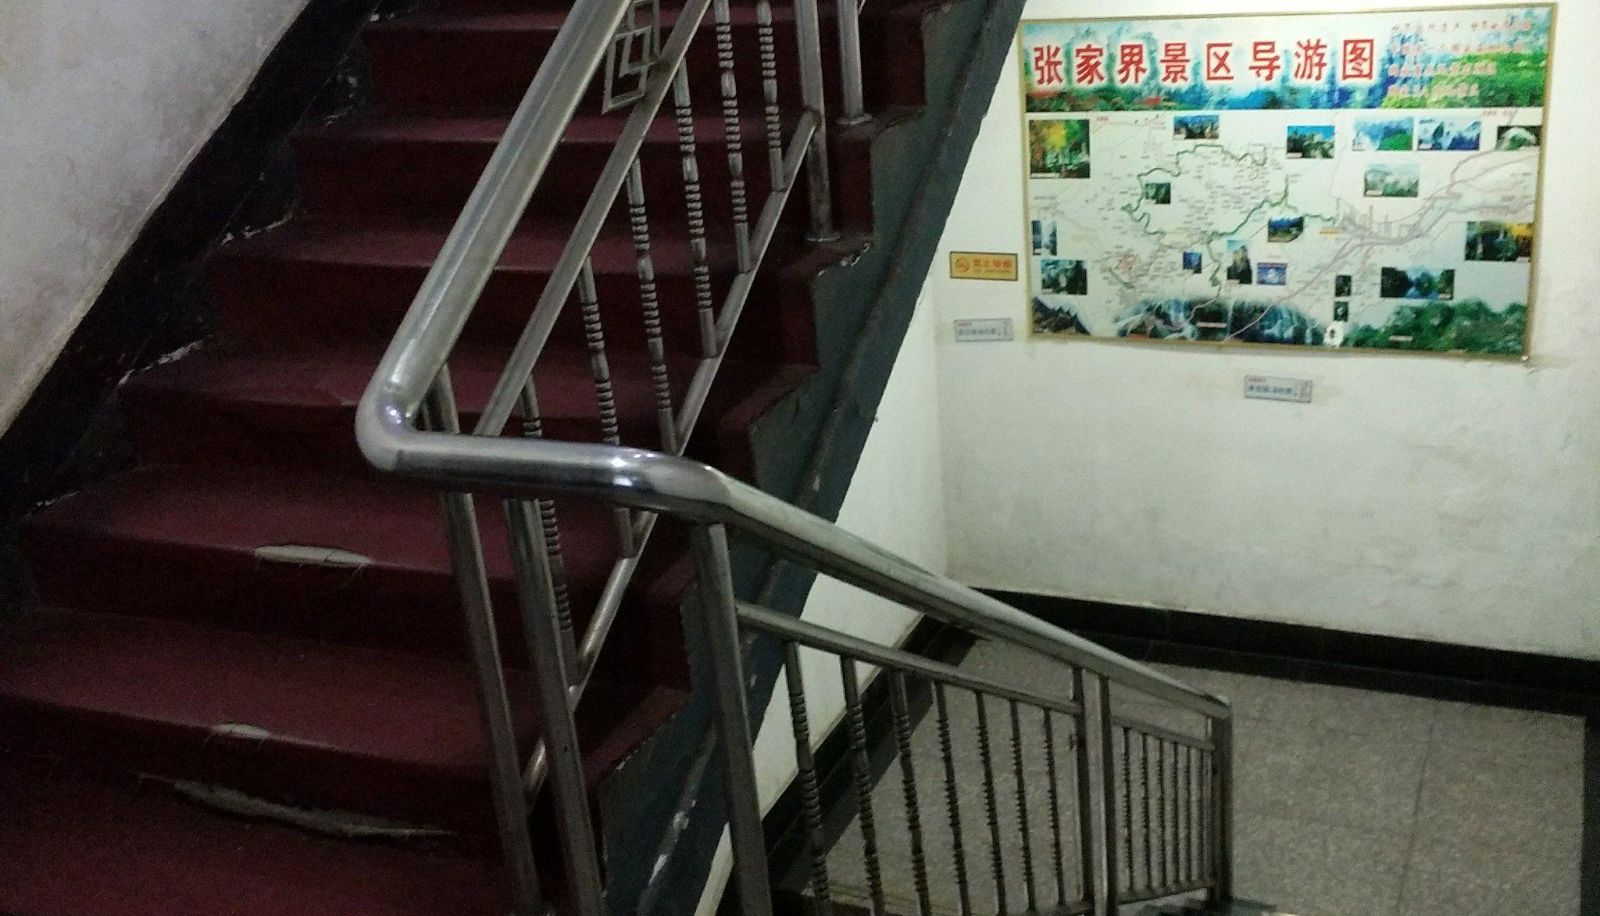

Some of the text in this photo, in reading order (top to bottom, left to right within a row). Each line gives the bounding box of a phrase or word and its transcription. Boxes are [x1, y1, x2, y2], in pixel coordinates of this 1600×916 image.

[1034, 39, 1374, 84] 张家界景区导游图
